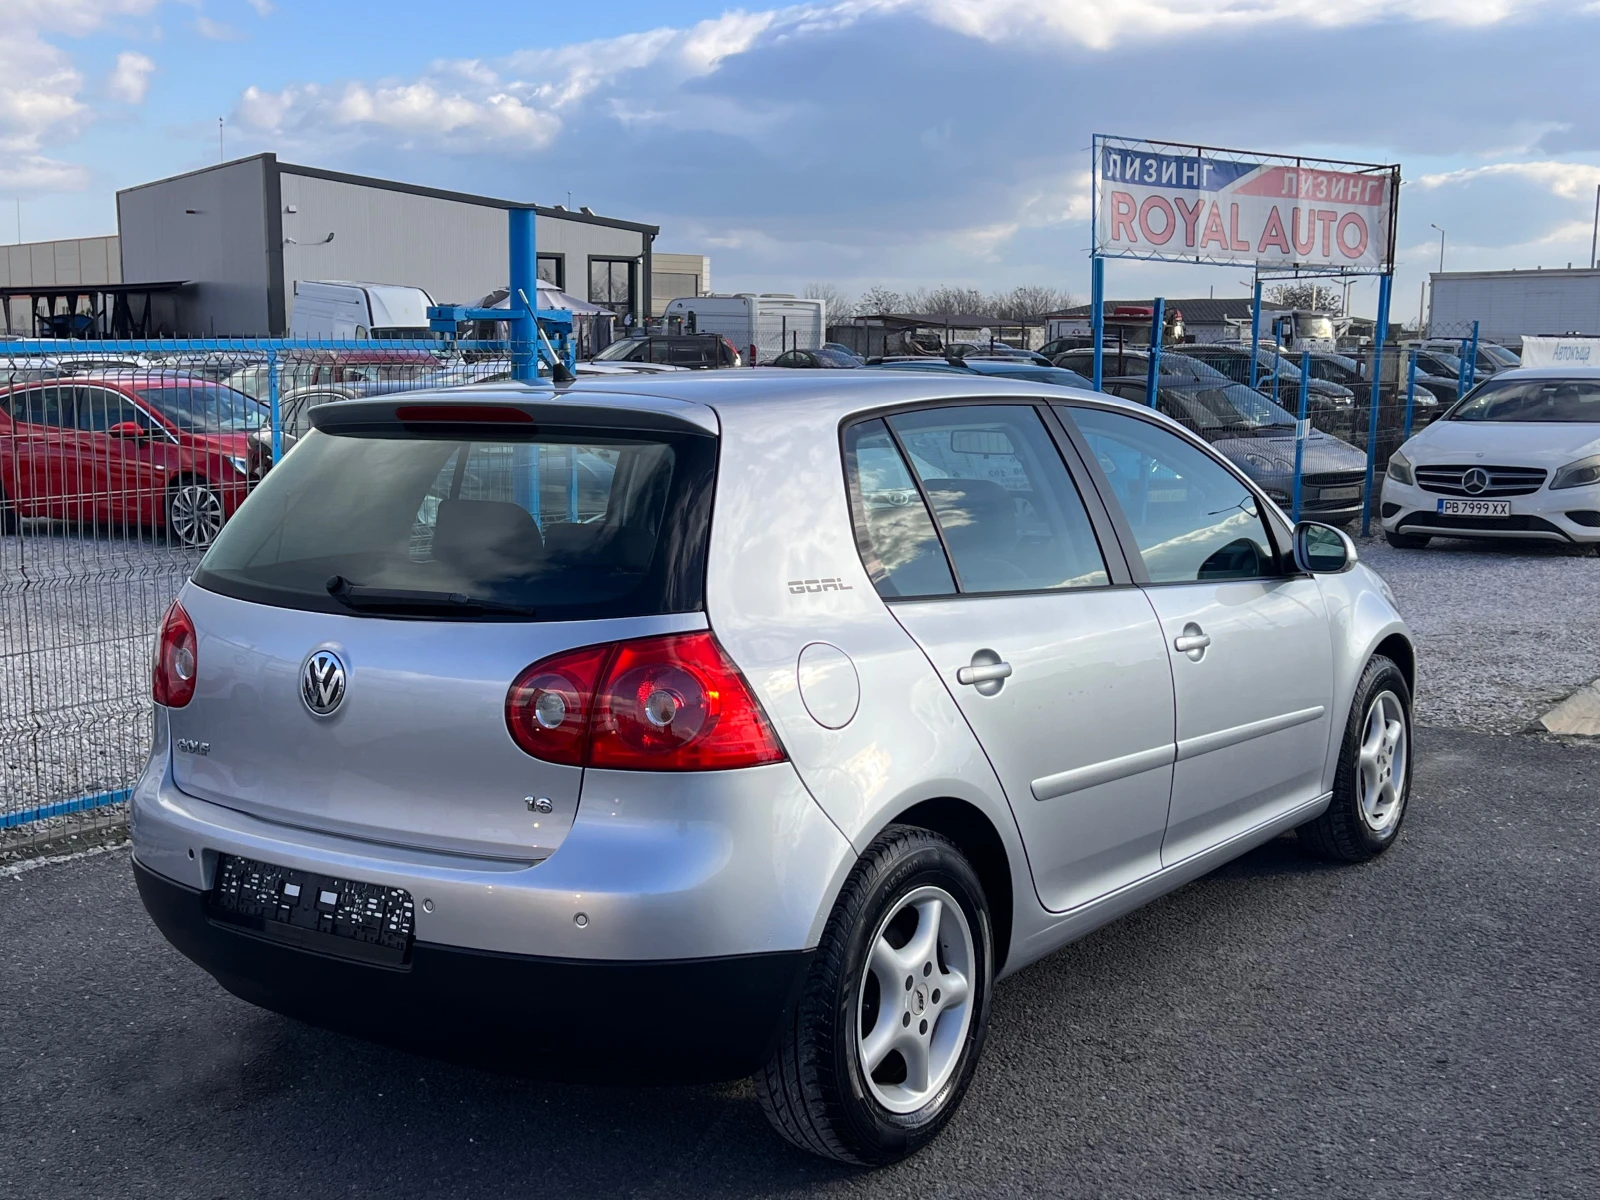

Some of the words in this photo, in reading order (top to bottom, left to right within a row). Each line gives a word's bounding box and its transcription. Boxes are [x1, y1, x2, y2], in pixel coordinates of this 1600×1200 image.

[1107, 154, 1214, 187] ЛИЗИНГ
[1281, 172, 1378, 202] ЛИЗИНГ
[1111, 190, 1250, 252] ROYAL
[1257, 205, 1369, 259] AUTO
[1445, 501, 1460, 514] PB
[1461, 502, 1490, 515] 7999
[1491, 503, 1508, 515] XX
[787, 577, 853, 595] GOAL
